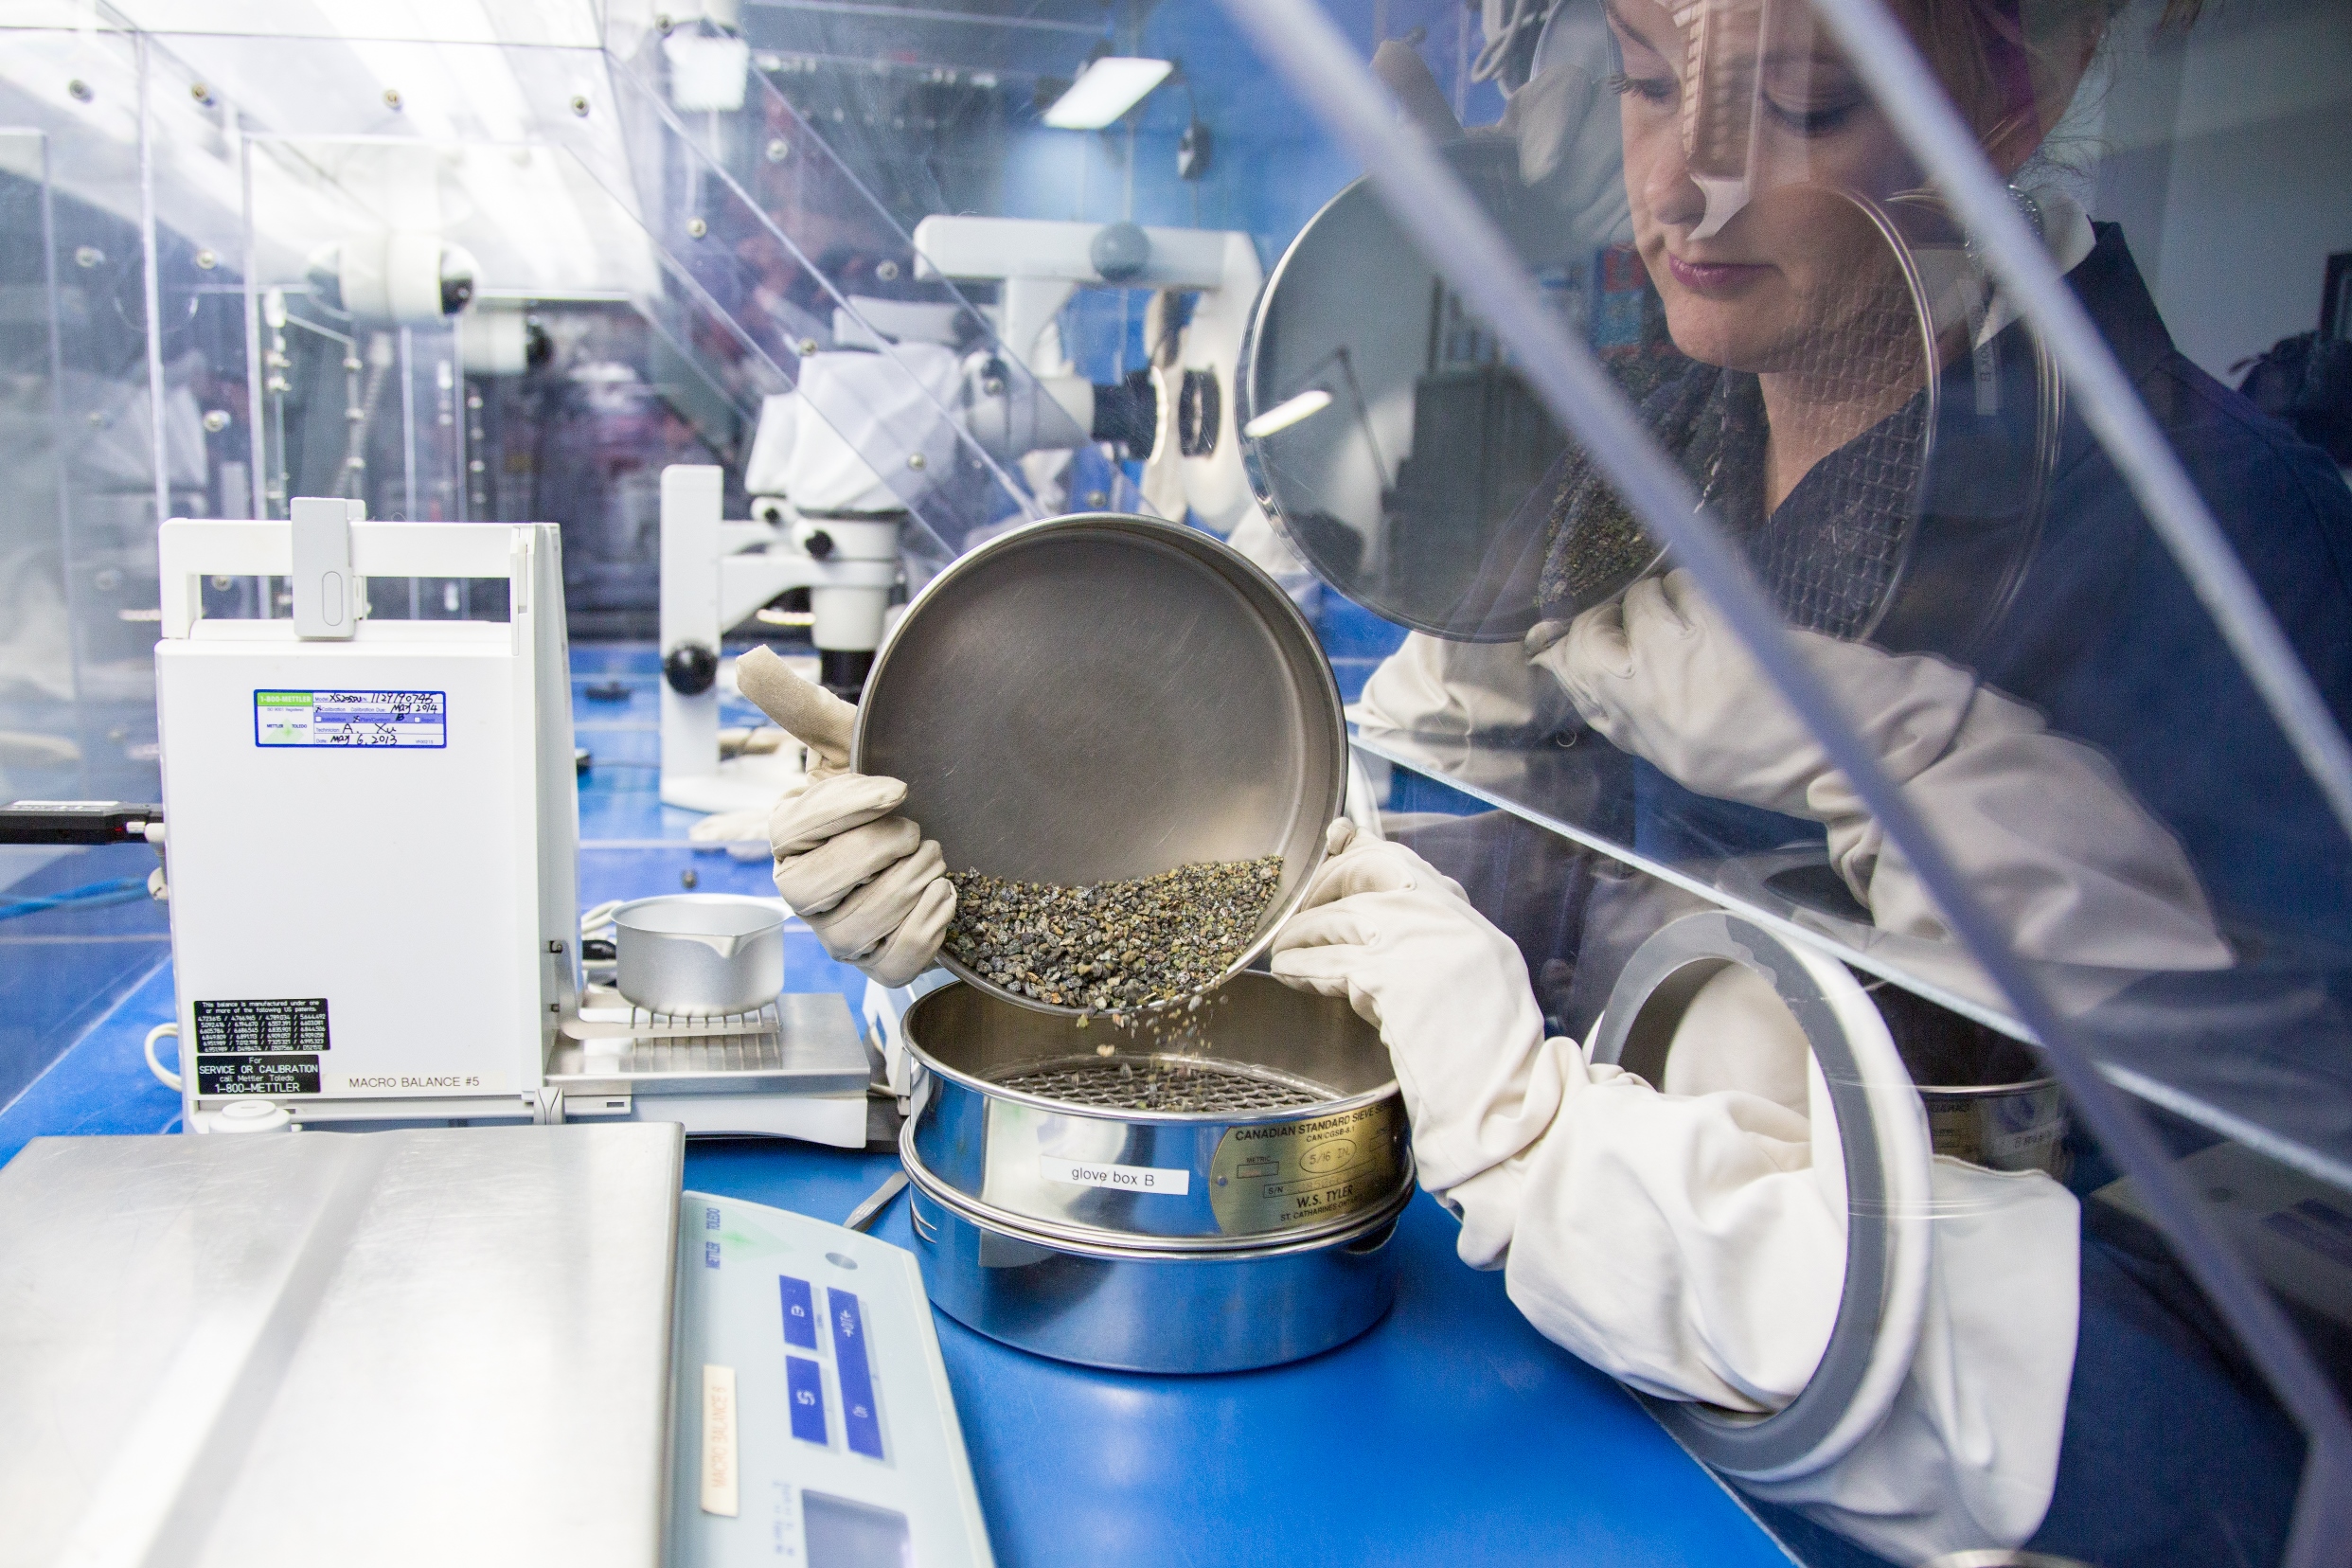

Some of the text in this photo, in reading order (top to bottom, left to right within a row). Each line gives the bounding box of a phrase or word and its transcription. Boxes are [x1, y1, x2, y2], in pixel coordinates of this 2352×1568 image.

[416, 704, 437, 714] 2014
[372, 735, 397, 744] 2013
[199, 1064, 318, 1074] SERVICE OR CALIBRATION
[215, 1083, 299, 1093] 1-800-METTLER
[349, 1077, 479, 1088] MACRO BALANCE #5
[1235, 1125, 1295, 1141] CANADIAN
[1298, 1114, 1350, 1134] STANDARD
[1352, 1109, 1373, 1123] SIEVE
[1309, 1151, 1331, 1166] 5/16
[1072, 1167, 1154, 1186] glove box B
[1268, 1186, 1284, 1195] S/N
[1296, 1185, 1353, 1208] W.S. TYLER
[705, 1208, 721, 1230] TOLEDO
[1295, 1203, 1337, 1220] CATHARINES
[710, 1395, 727, 1443] BALANCE
[710, 1447, 727, 1488] MACRO
